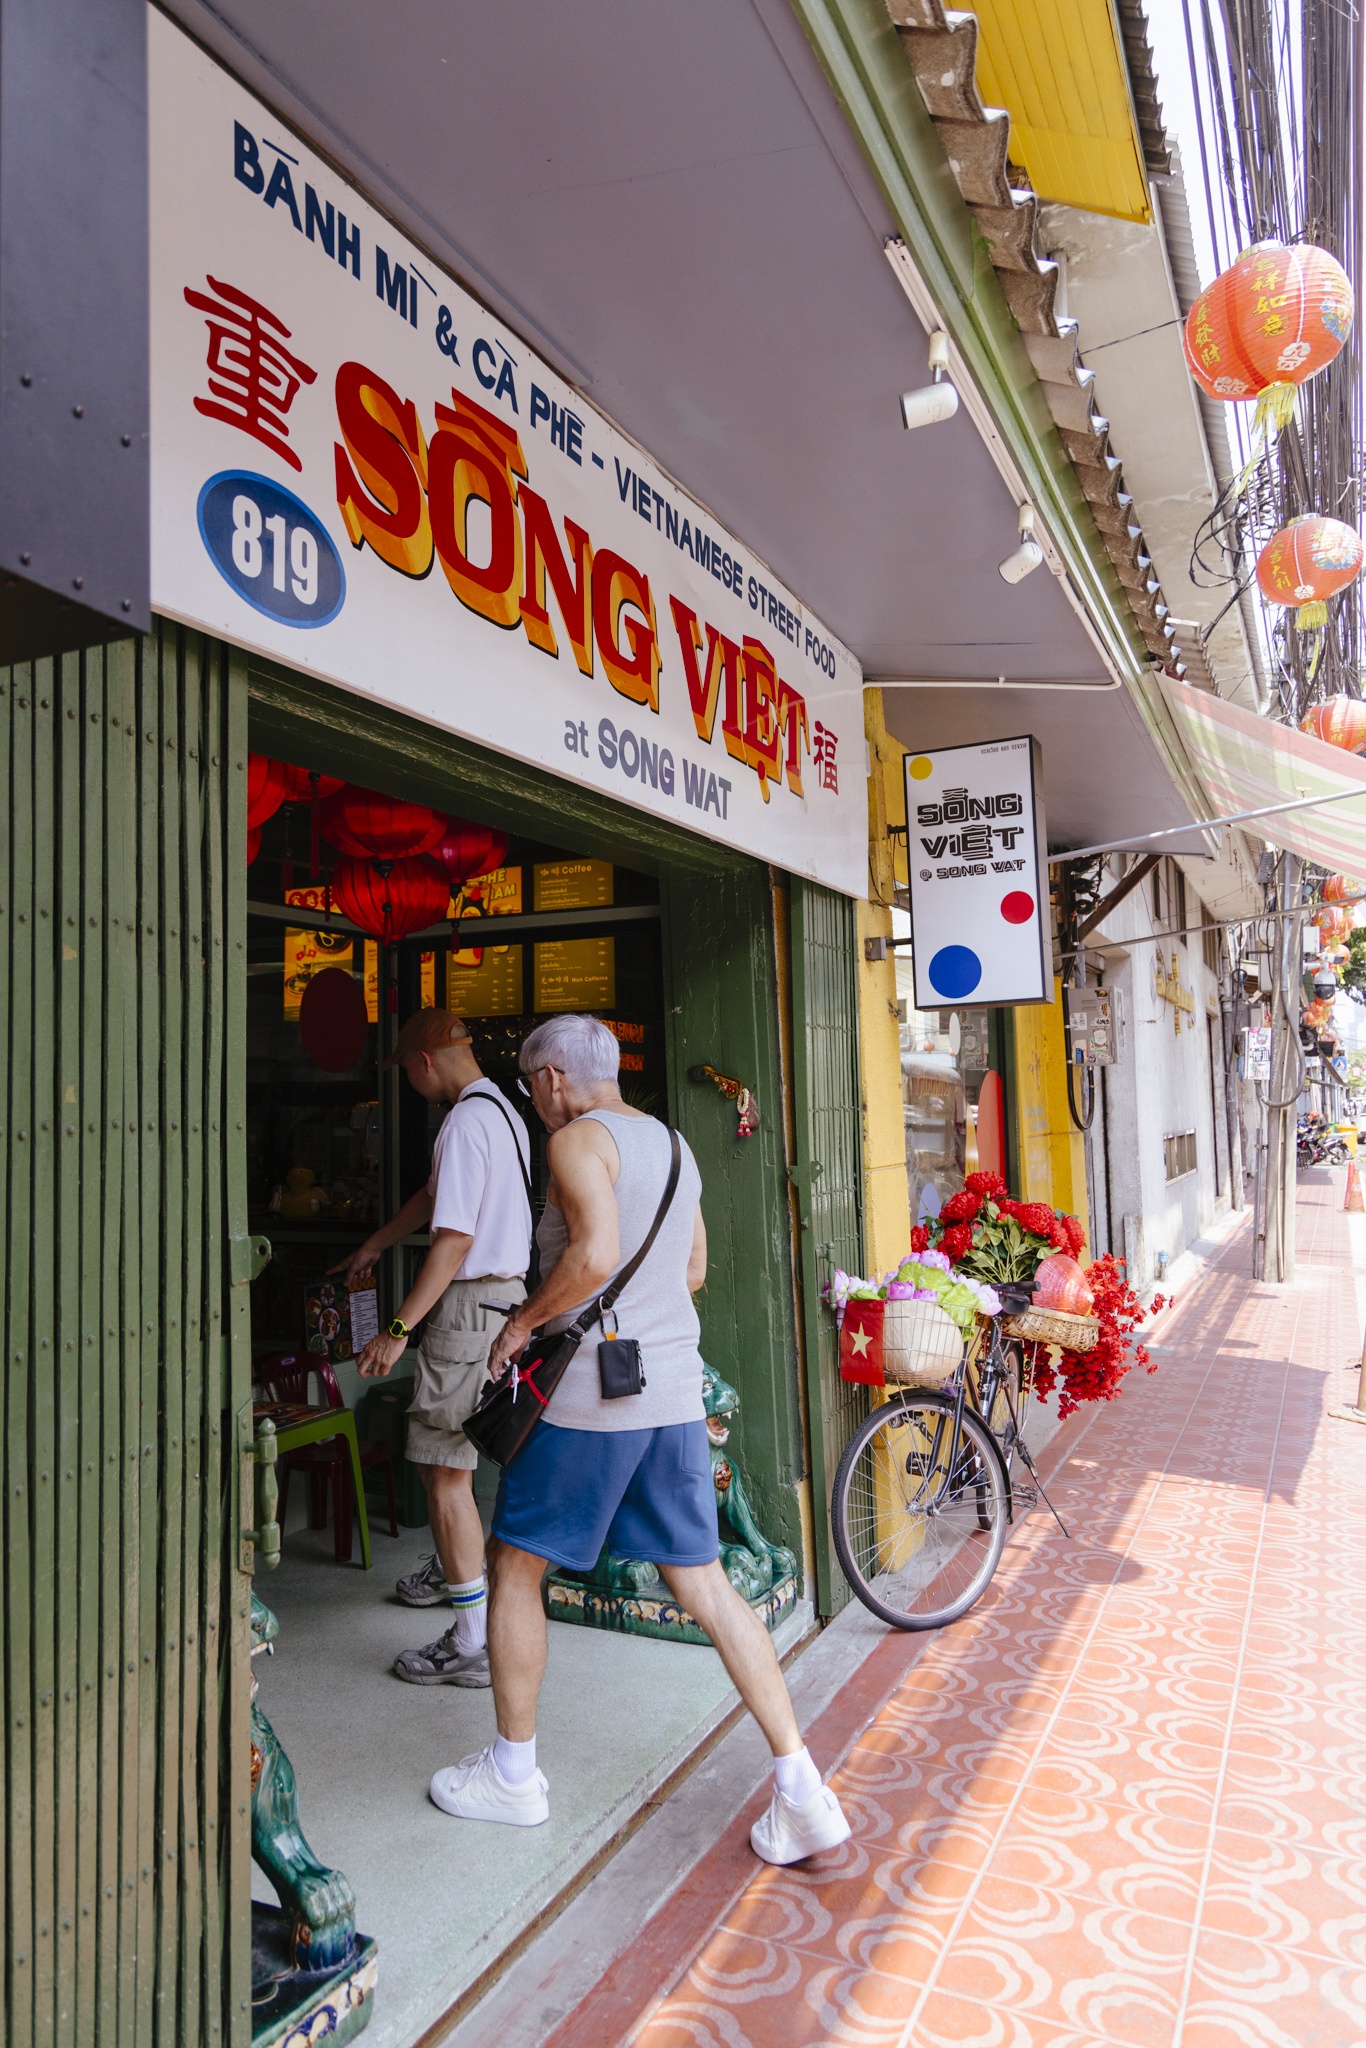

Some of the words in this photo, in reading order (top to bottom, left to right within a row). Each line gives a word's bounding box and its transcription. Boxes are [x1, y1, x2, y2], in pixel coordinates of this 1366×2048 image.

[435, 304, 461, 367] &
[530, 383, 586, 467] PHÊ
[614, 456, 743, 599] VIETNAMESE
[747, 575, 802, 649] STREET
[805, 629, 836, 680] FOOD
[232, 495, 319, 605] 819
[669, 594, 810, 804] VIỆT
[564, 719, 589, 758] at
[597, 717, 675, 796] SONG
[683, 758, 732, 821] WAT
[814, 720, 839, 796] 福
[562, 864, 592, 875] Coffee
[919, 868, 932, 881] @
[936, 863, 987, 880] SONG
[992, 859, 1026, 873] WAT
